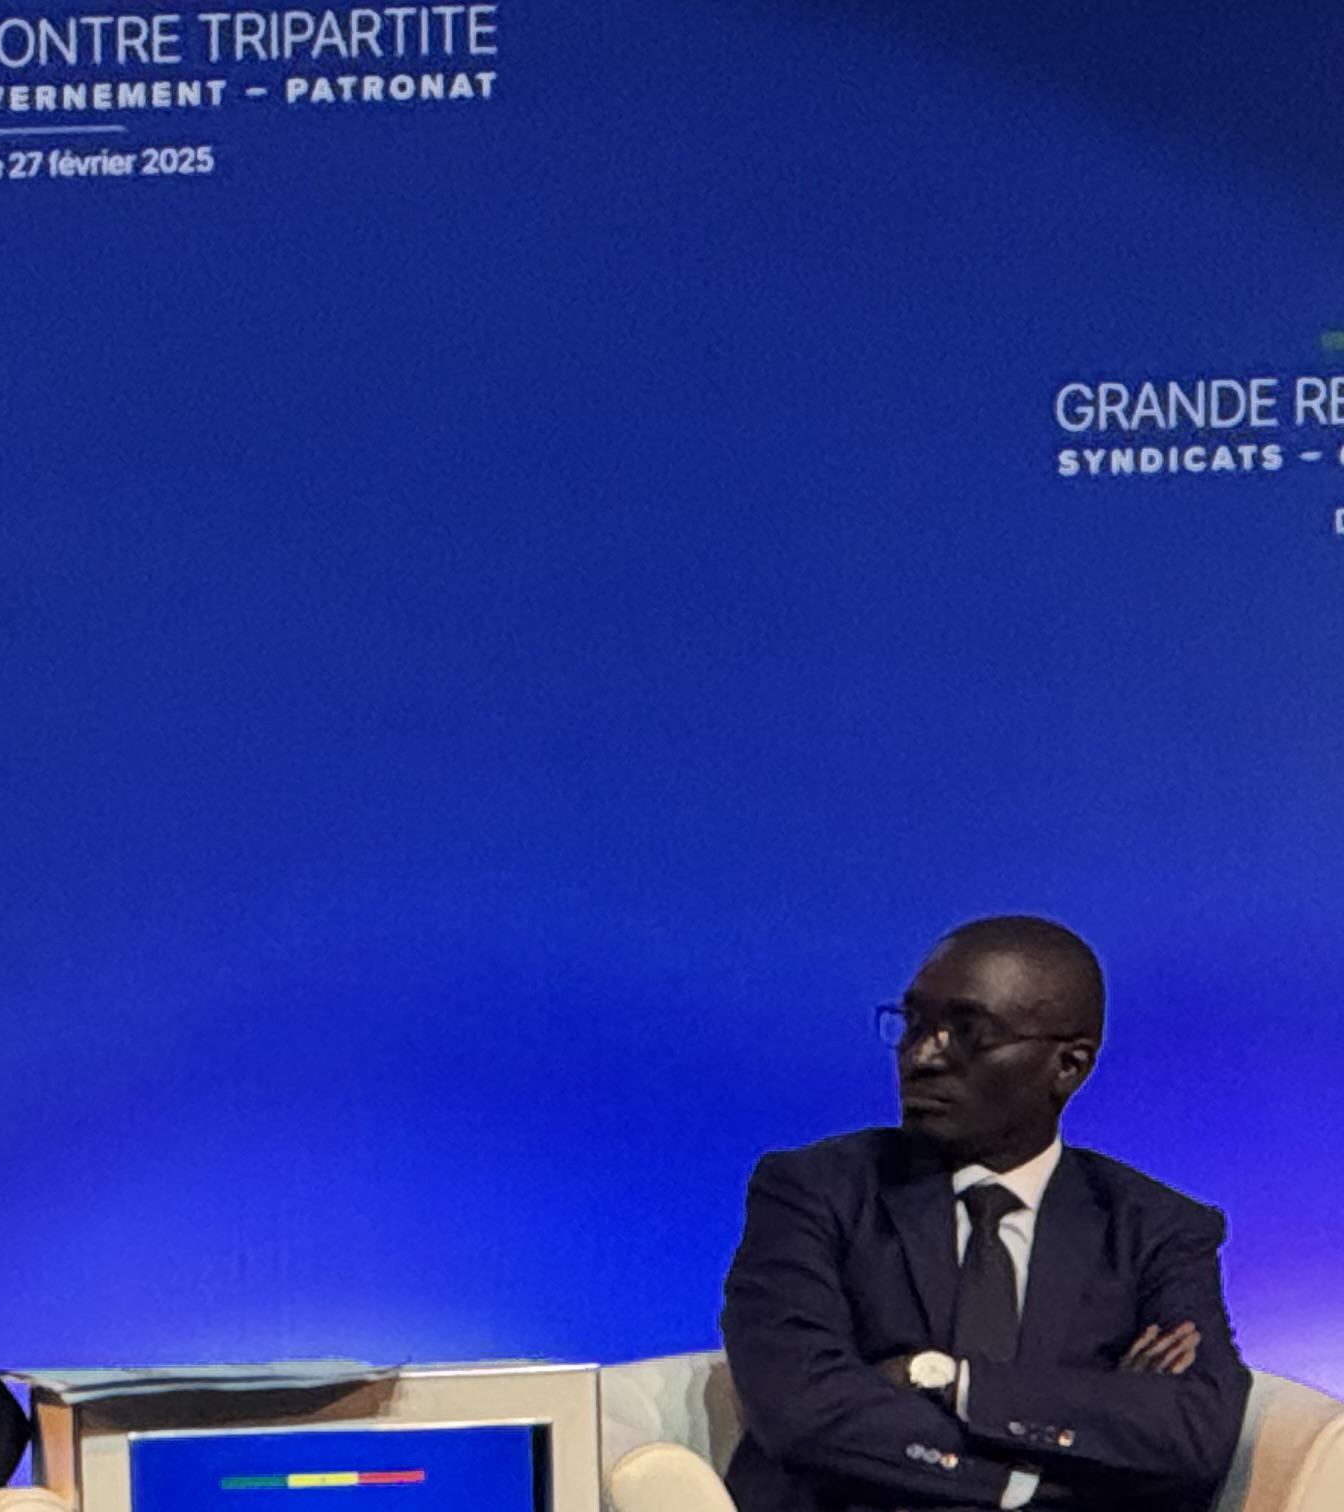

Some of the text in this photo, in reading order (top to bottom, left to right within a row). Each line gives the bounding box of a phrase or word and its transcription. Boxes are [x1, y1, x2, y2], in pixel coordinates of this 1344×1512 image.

[198, 4, 498, 62] TRIPARTITE
[286, 71, 497, 103] PATRONAT
[8, 151, 44, 179] 27
[48, 148, 137, 177] février
[141, 146, 215, 175] 2025
[1055, 378, 1278, 432] GRANDE
[1058, 443, 1283, 476] SYNDICATS
